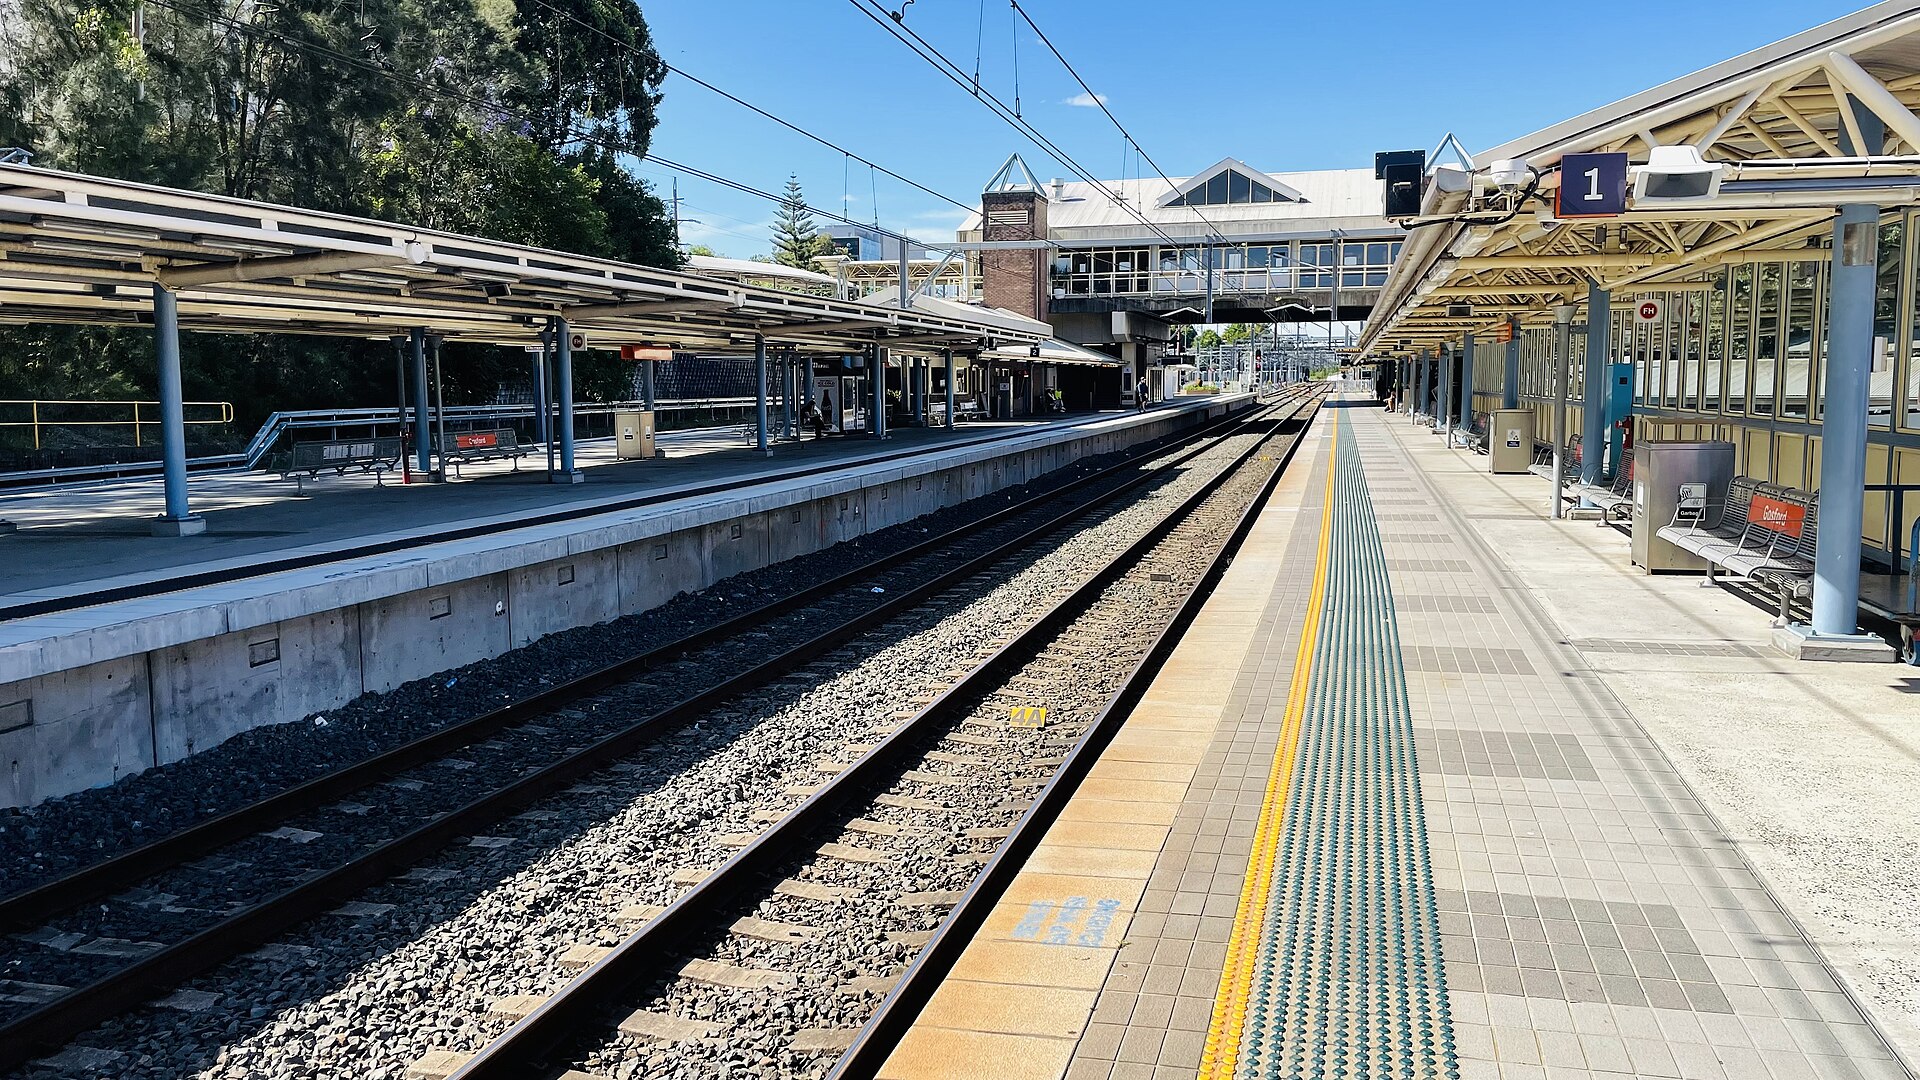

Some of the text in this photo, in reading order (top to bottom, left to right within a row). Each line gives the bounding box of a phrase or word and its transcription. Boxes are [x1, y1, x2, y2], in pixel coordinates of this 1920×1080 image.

[1584, 167, 1603, 200] 1
[1763, 504, 1788, 526] Gosford
[1011, 708, 1043, 726] 4A
